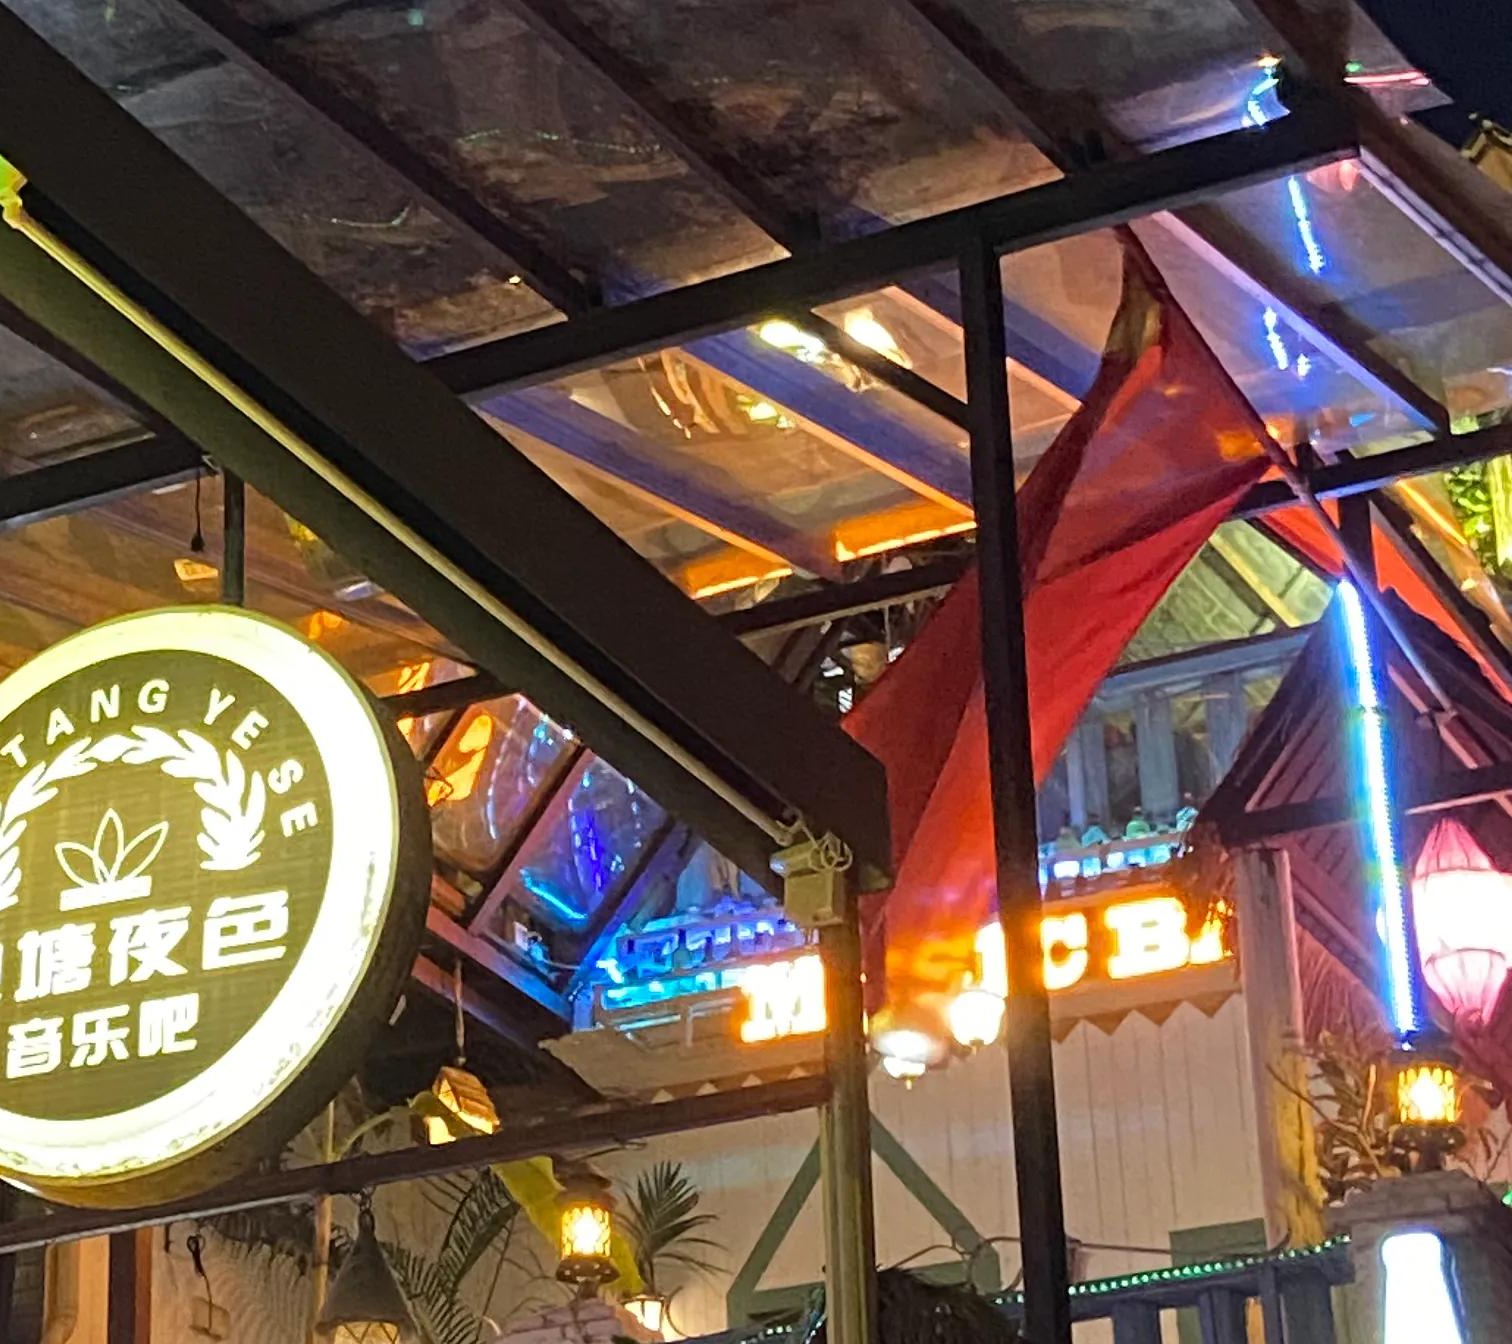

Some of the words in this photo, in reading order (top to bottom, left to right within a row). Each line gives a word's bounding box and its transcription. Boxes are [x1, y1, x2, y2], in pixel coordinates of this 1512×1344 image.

[0, 677, 172, 769] TANG
[202, 686, 270, 750] YE
[268, 758, 318, 839] SE
[5, 993, 200, 1079] 音乐吧
